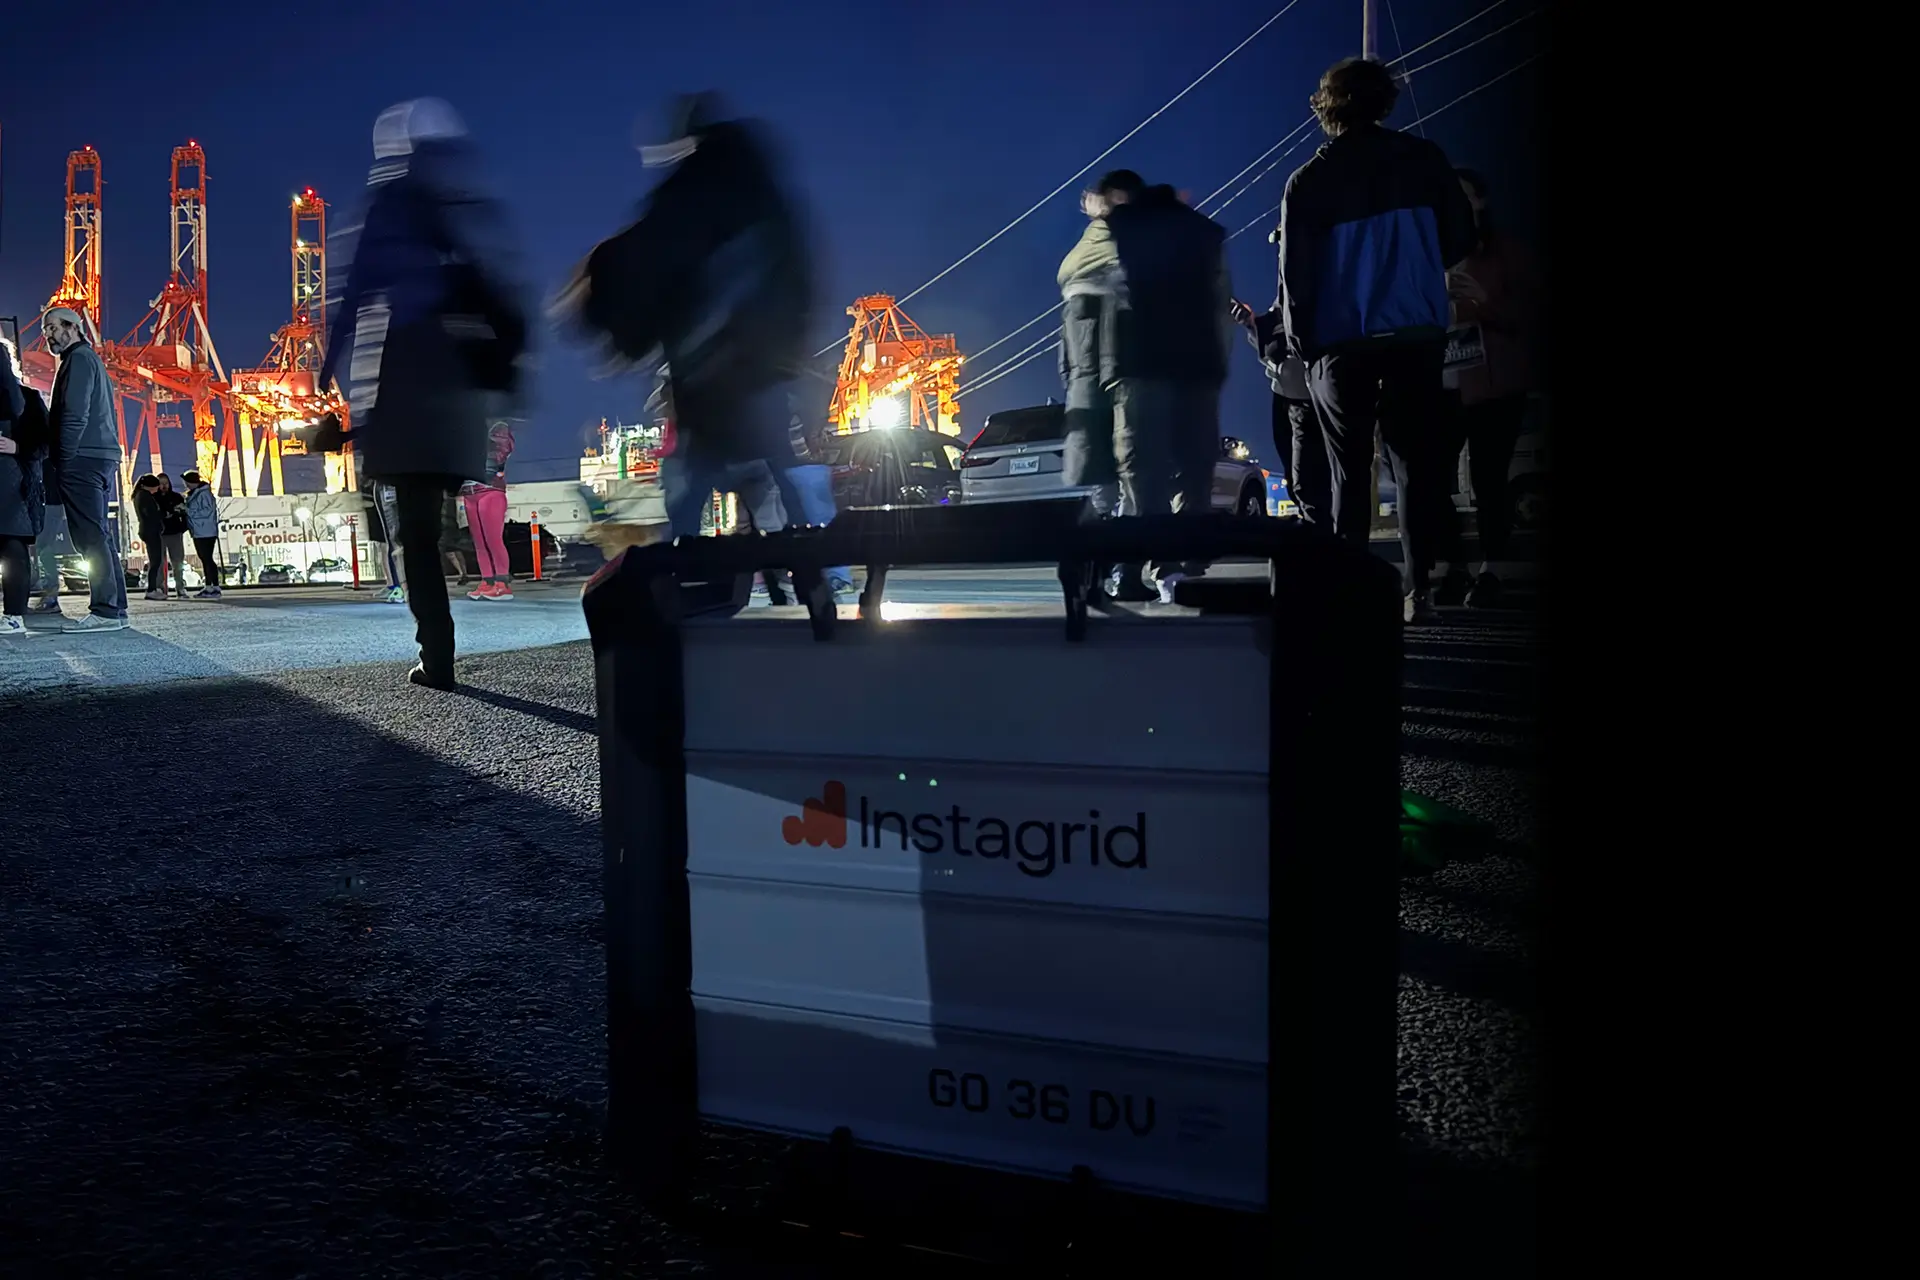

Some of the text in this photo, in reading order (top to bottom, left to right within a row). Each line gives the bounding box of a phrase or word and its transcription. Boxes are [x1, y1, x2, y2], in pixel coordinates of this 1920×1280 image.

[243, 530, 312, 546] Tropical
[861, 796, 1147, 877] Instagrid
[928, 1068, 989, 1112] GO
[1007, 1079, 1070, 1124] 36
